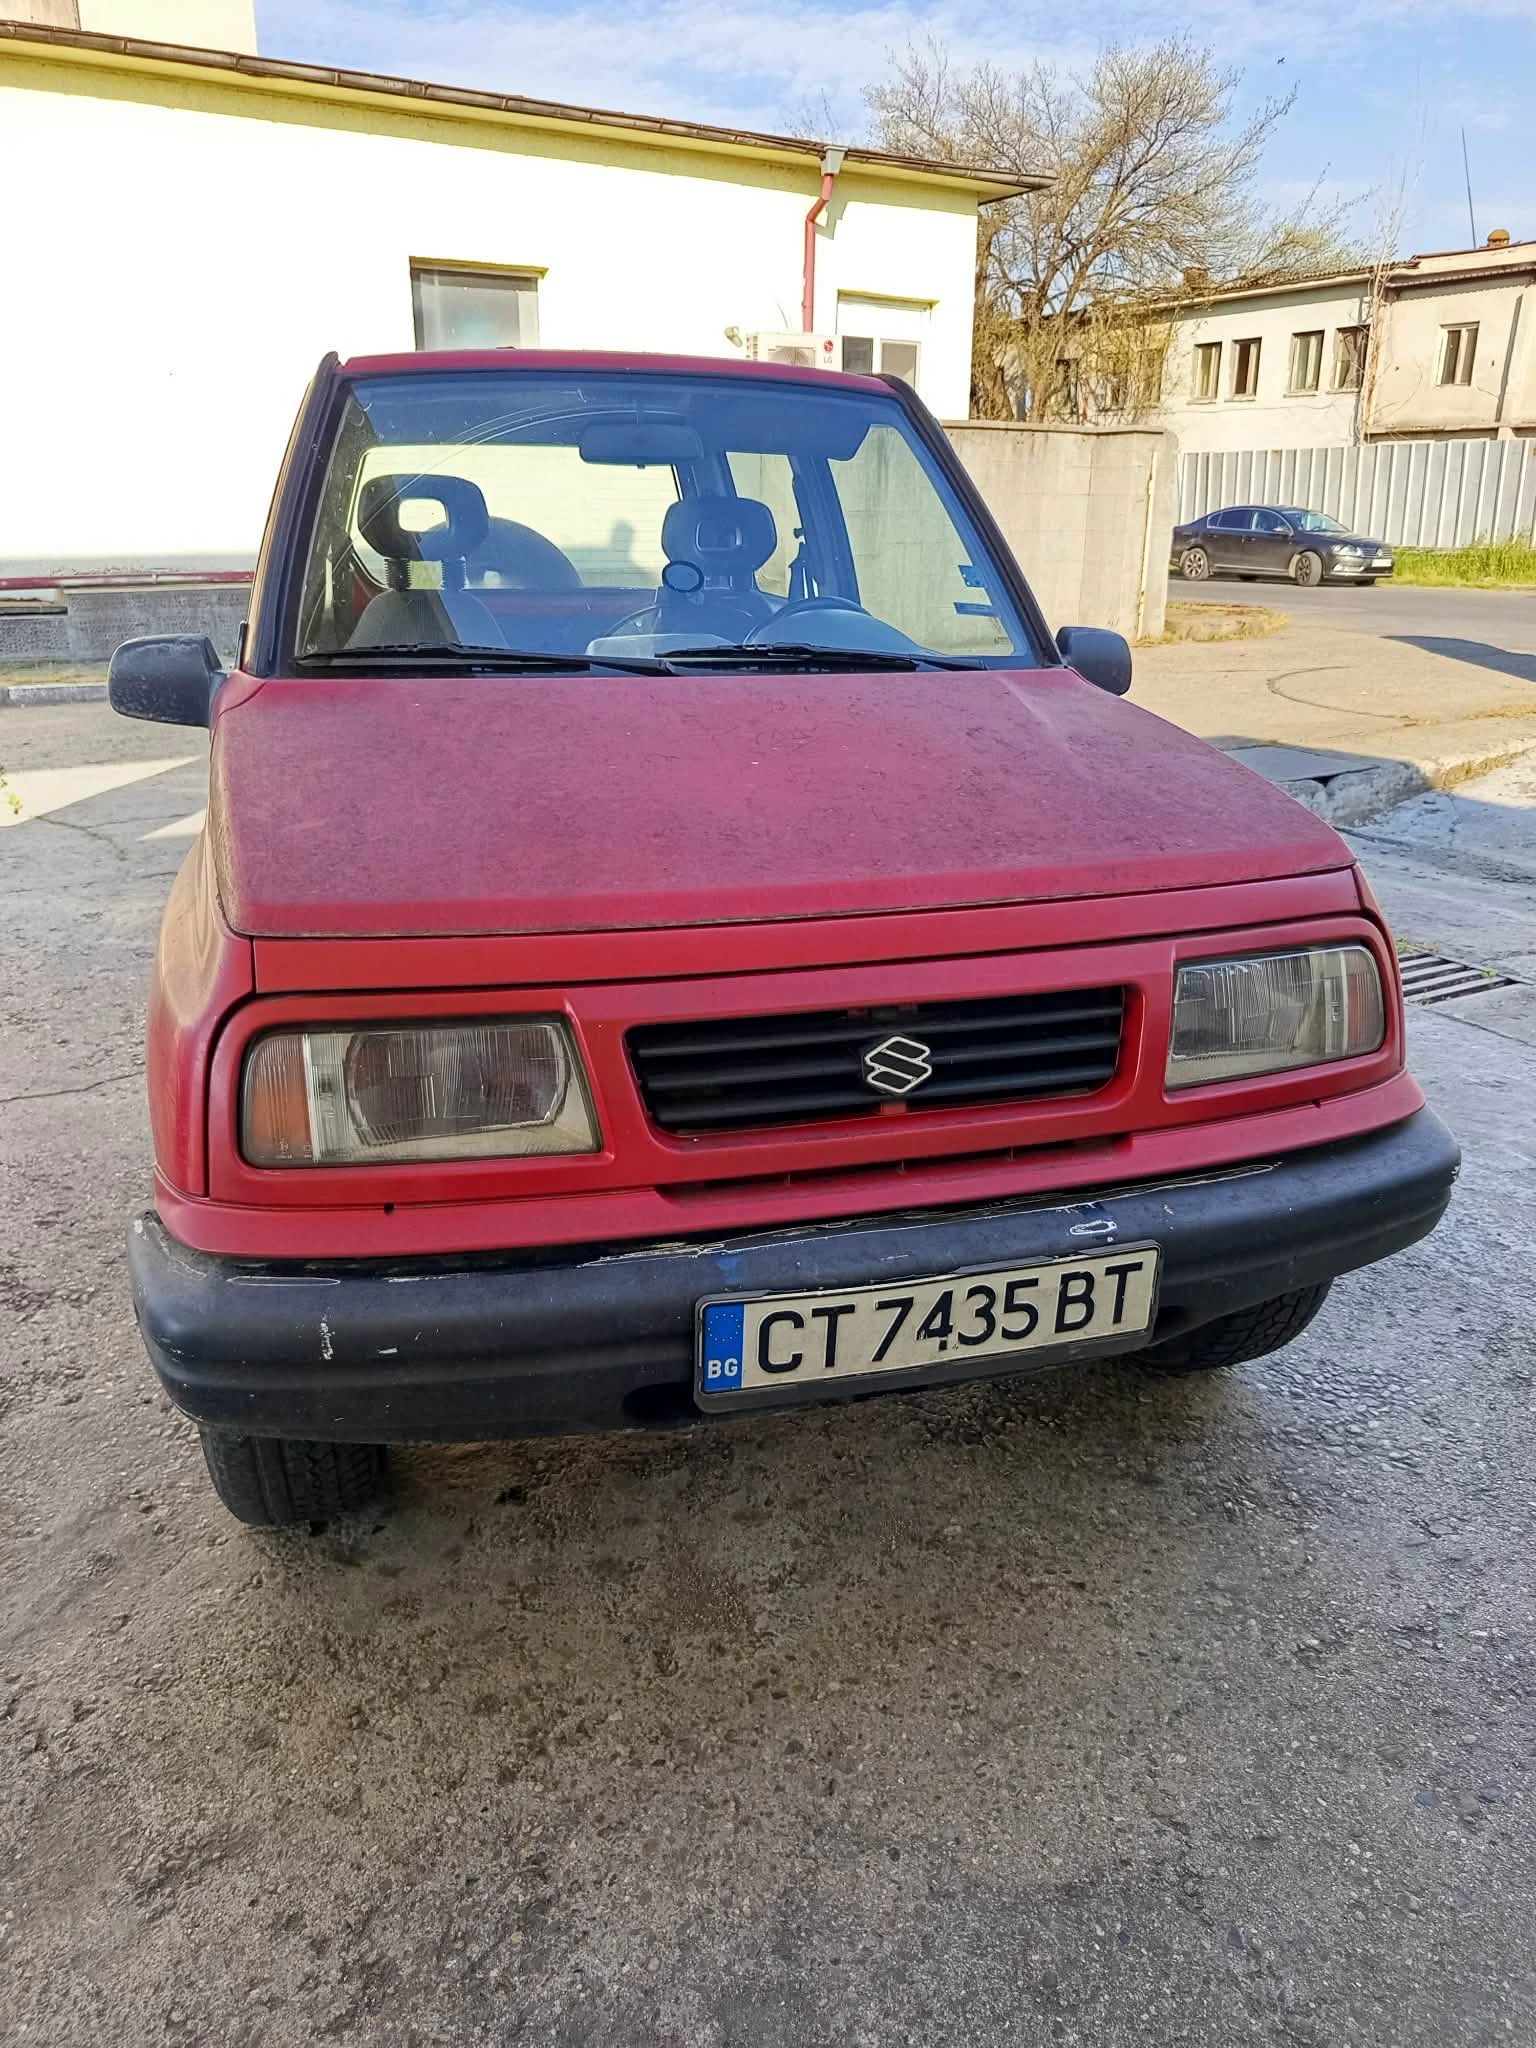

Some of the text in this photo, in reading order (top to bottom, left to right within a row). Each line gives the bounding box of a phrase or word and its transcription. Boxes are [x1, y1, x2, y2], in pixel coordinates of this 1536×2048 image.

[758, 1261, 1143, 1374] CT 7435 BT
[708, 1358, 738, 1379] BG
